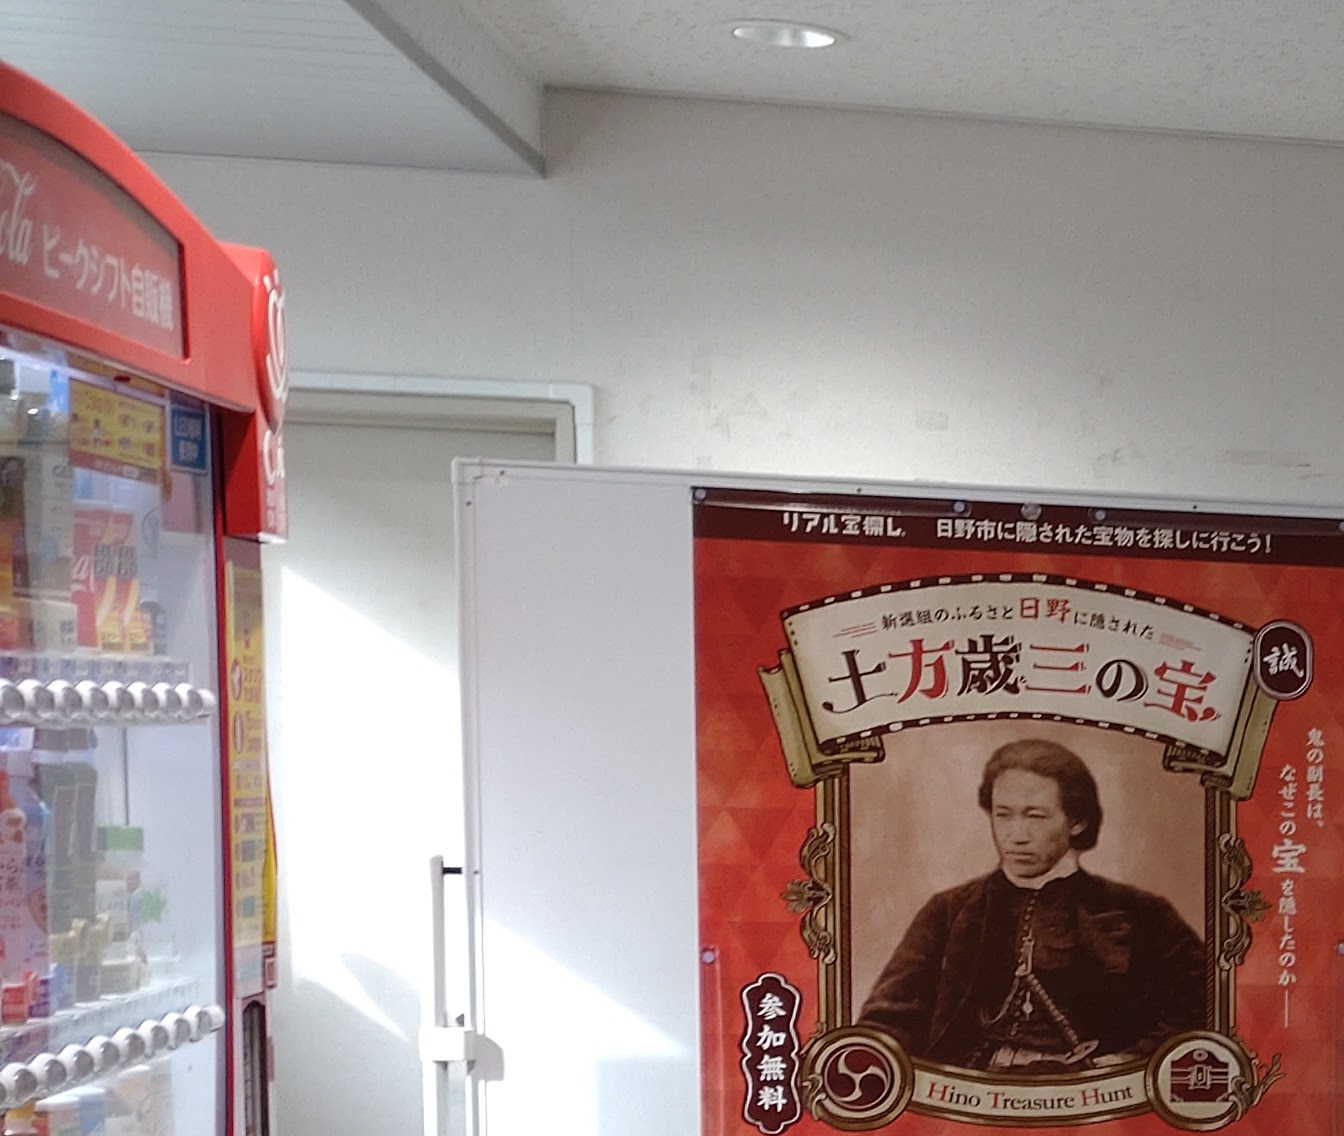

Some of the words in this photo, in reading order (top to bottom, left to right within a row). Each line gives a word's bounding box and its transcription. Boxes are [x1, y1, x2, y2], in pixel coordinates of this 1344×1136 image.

[783, 512, 902, 537] リアル宝探し
[937, 517, 1273, 554] 日野市に隠された宝物を探しに行こう!
[822, 632, 1222, 722] 土方歳三の宝
[1262, 645, 1304, 679] 誠
[1306, 727, 1326, 828] 鬼の副長は、
[756, 992, 787, 1113] 参加無料
[927, 1082, 981, 1109] Hino
[986, 1090, 1076, 1111] Treasure
[1081, 1084, 1134, 1108] Hunt
